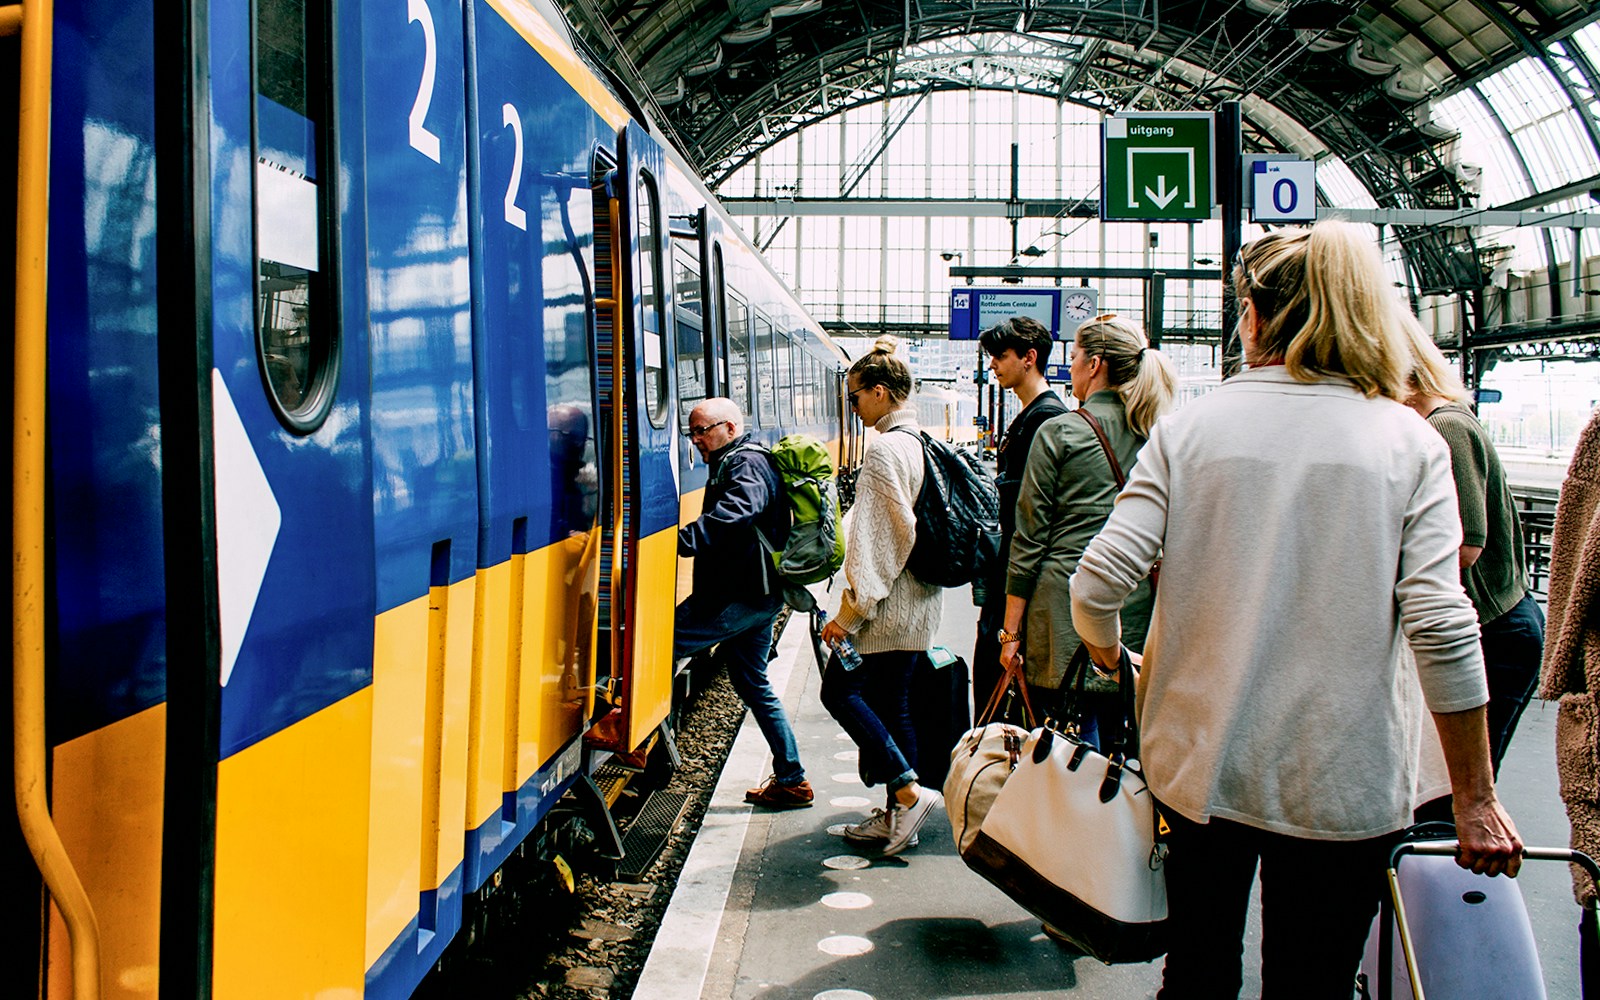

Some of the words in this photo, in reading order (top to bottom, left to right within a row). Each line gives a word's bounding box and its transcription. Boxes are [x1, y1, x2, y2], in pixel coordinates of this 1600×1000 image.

[408, 0, 441, 164] 2
[502, 103, 527, 231] 2
[1130, 125, 1174, 137] uitgang
[1273, 178, 1298, 214] 0
